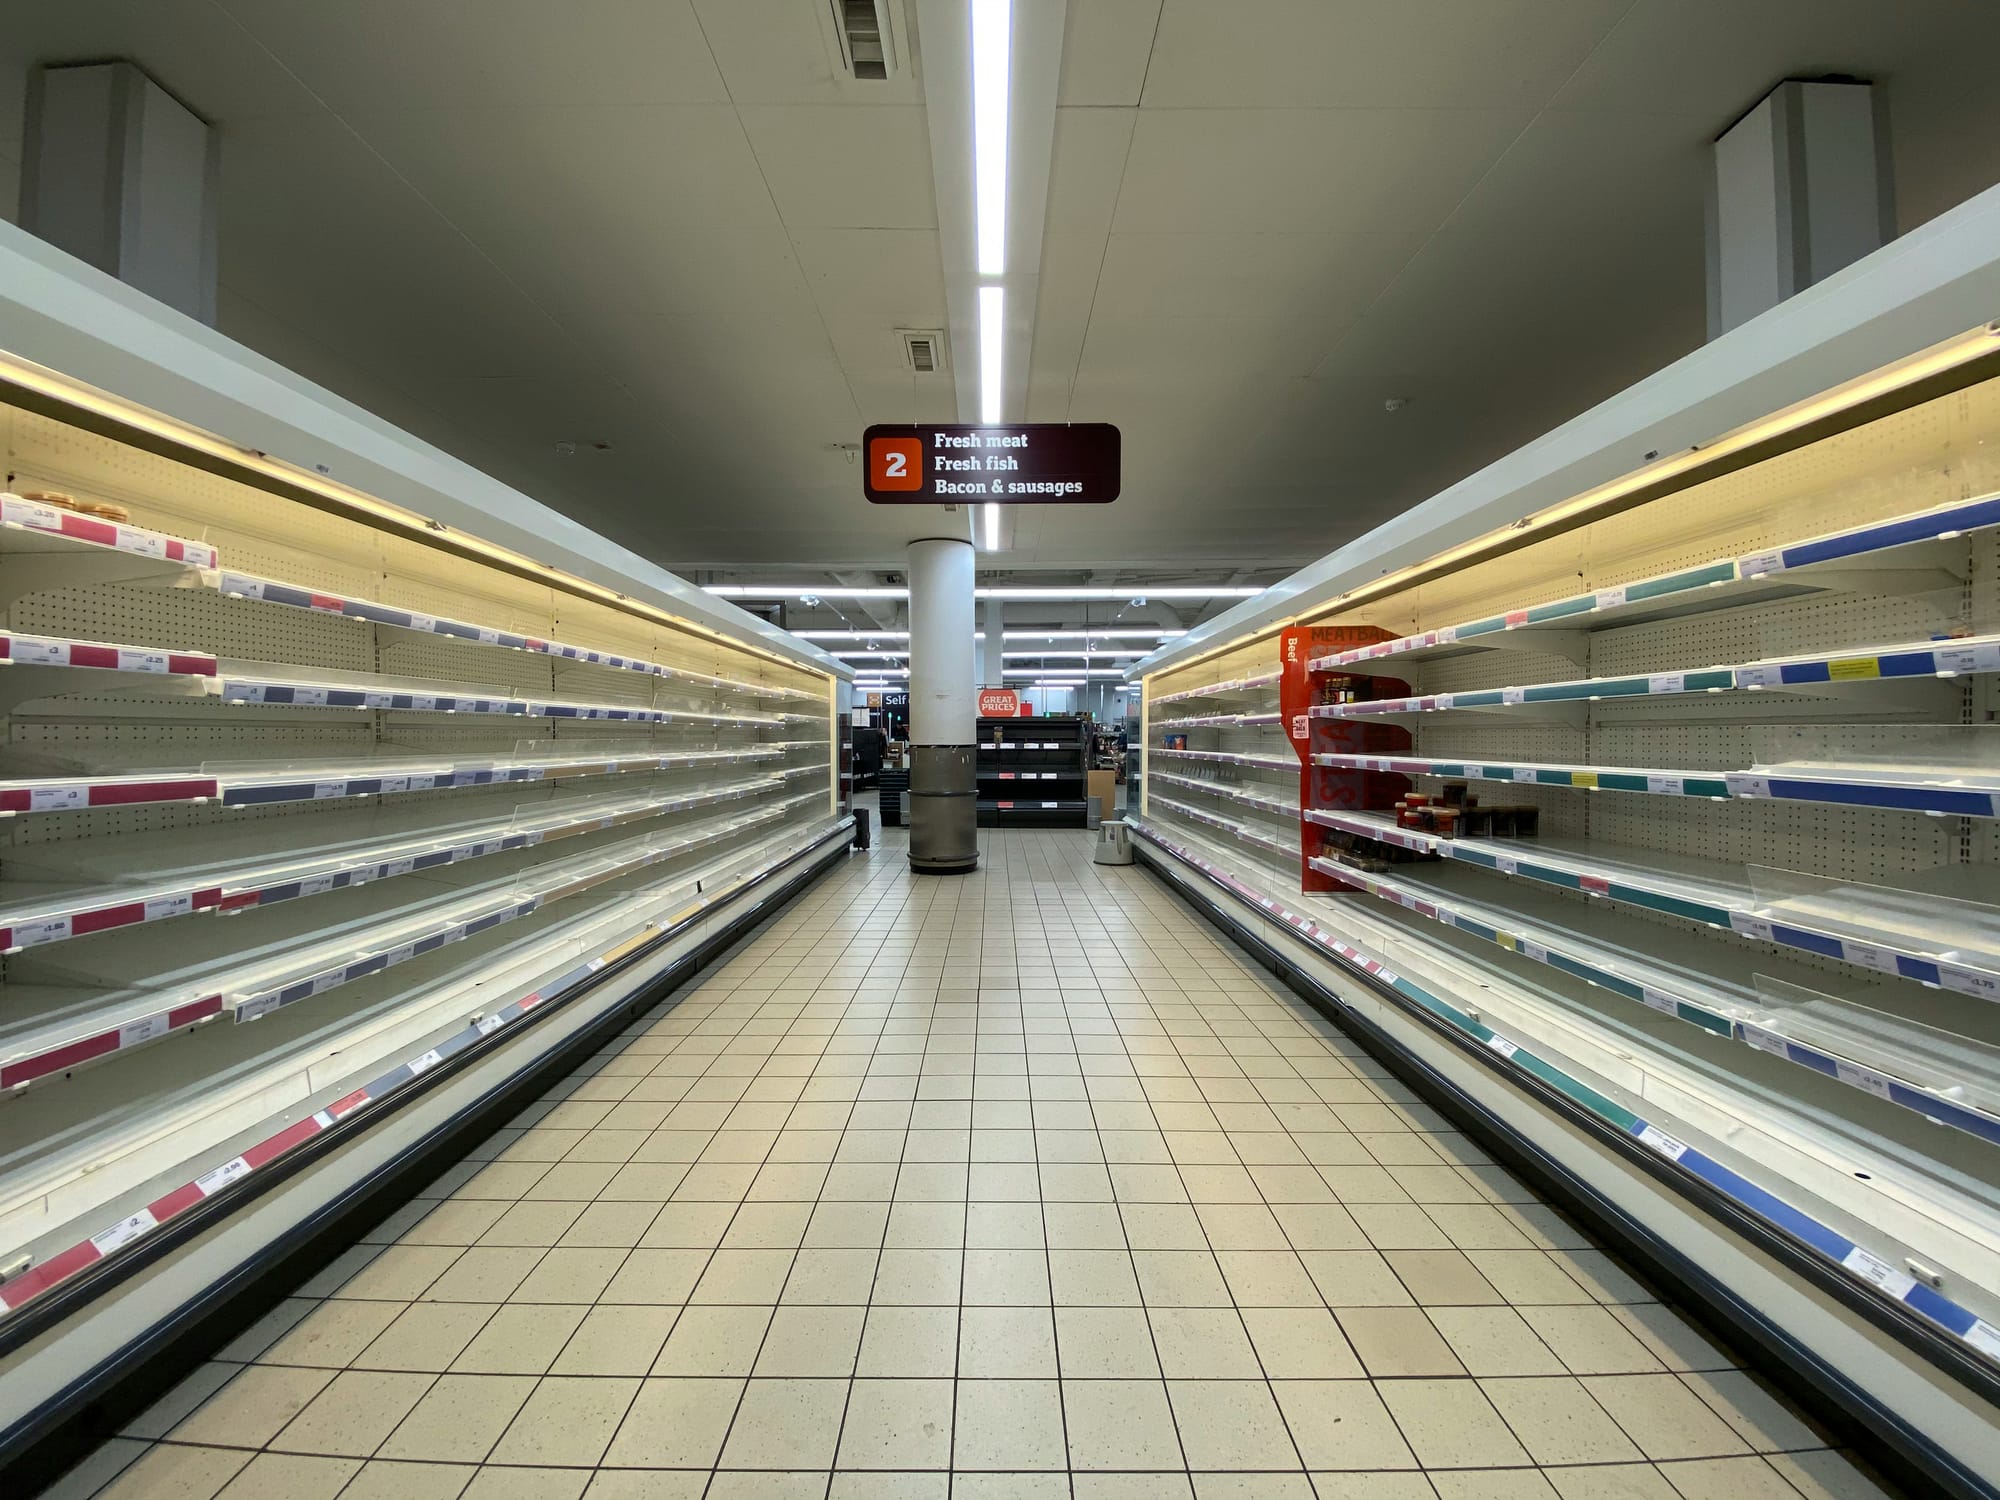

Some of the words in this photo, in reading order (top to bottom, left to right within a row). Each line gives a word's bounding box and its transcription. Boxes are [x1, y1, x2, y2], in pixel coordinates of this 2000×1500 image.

[934, 433, 981, 449] Fresh
[985, 433, 1028, 449] meat
[885, 452, 907, 478] 2
[934, 456, 981, 471] Fresh
[985, 456, 1019, 471] fish
[934, 479, 987, 494] Bacon
[991, 479, 1004, 494] &
[1007, 480, 1083, 496] sausages
[1287, 637, 1298, 663] Beef
[885, 694, 905, 705] Self
[981, 703, 1015, 711] PRICES
[983, 695, 1013, 704] GREAT
